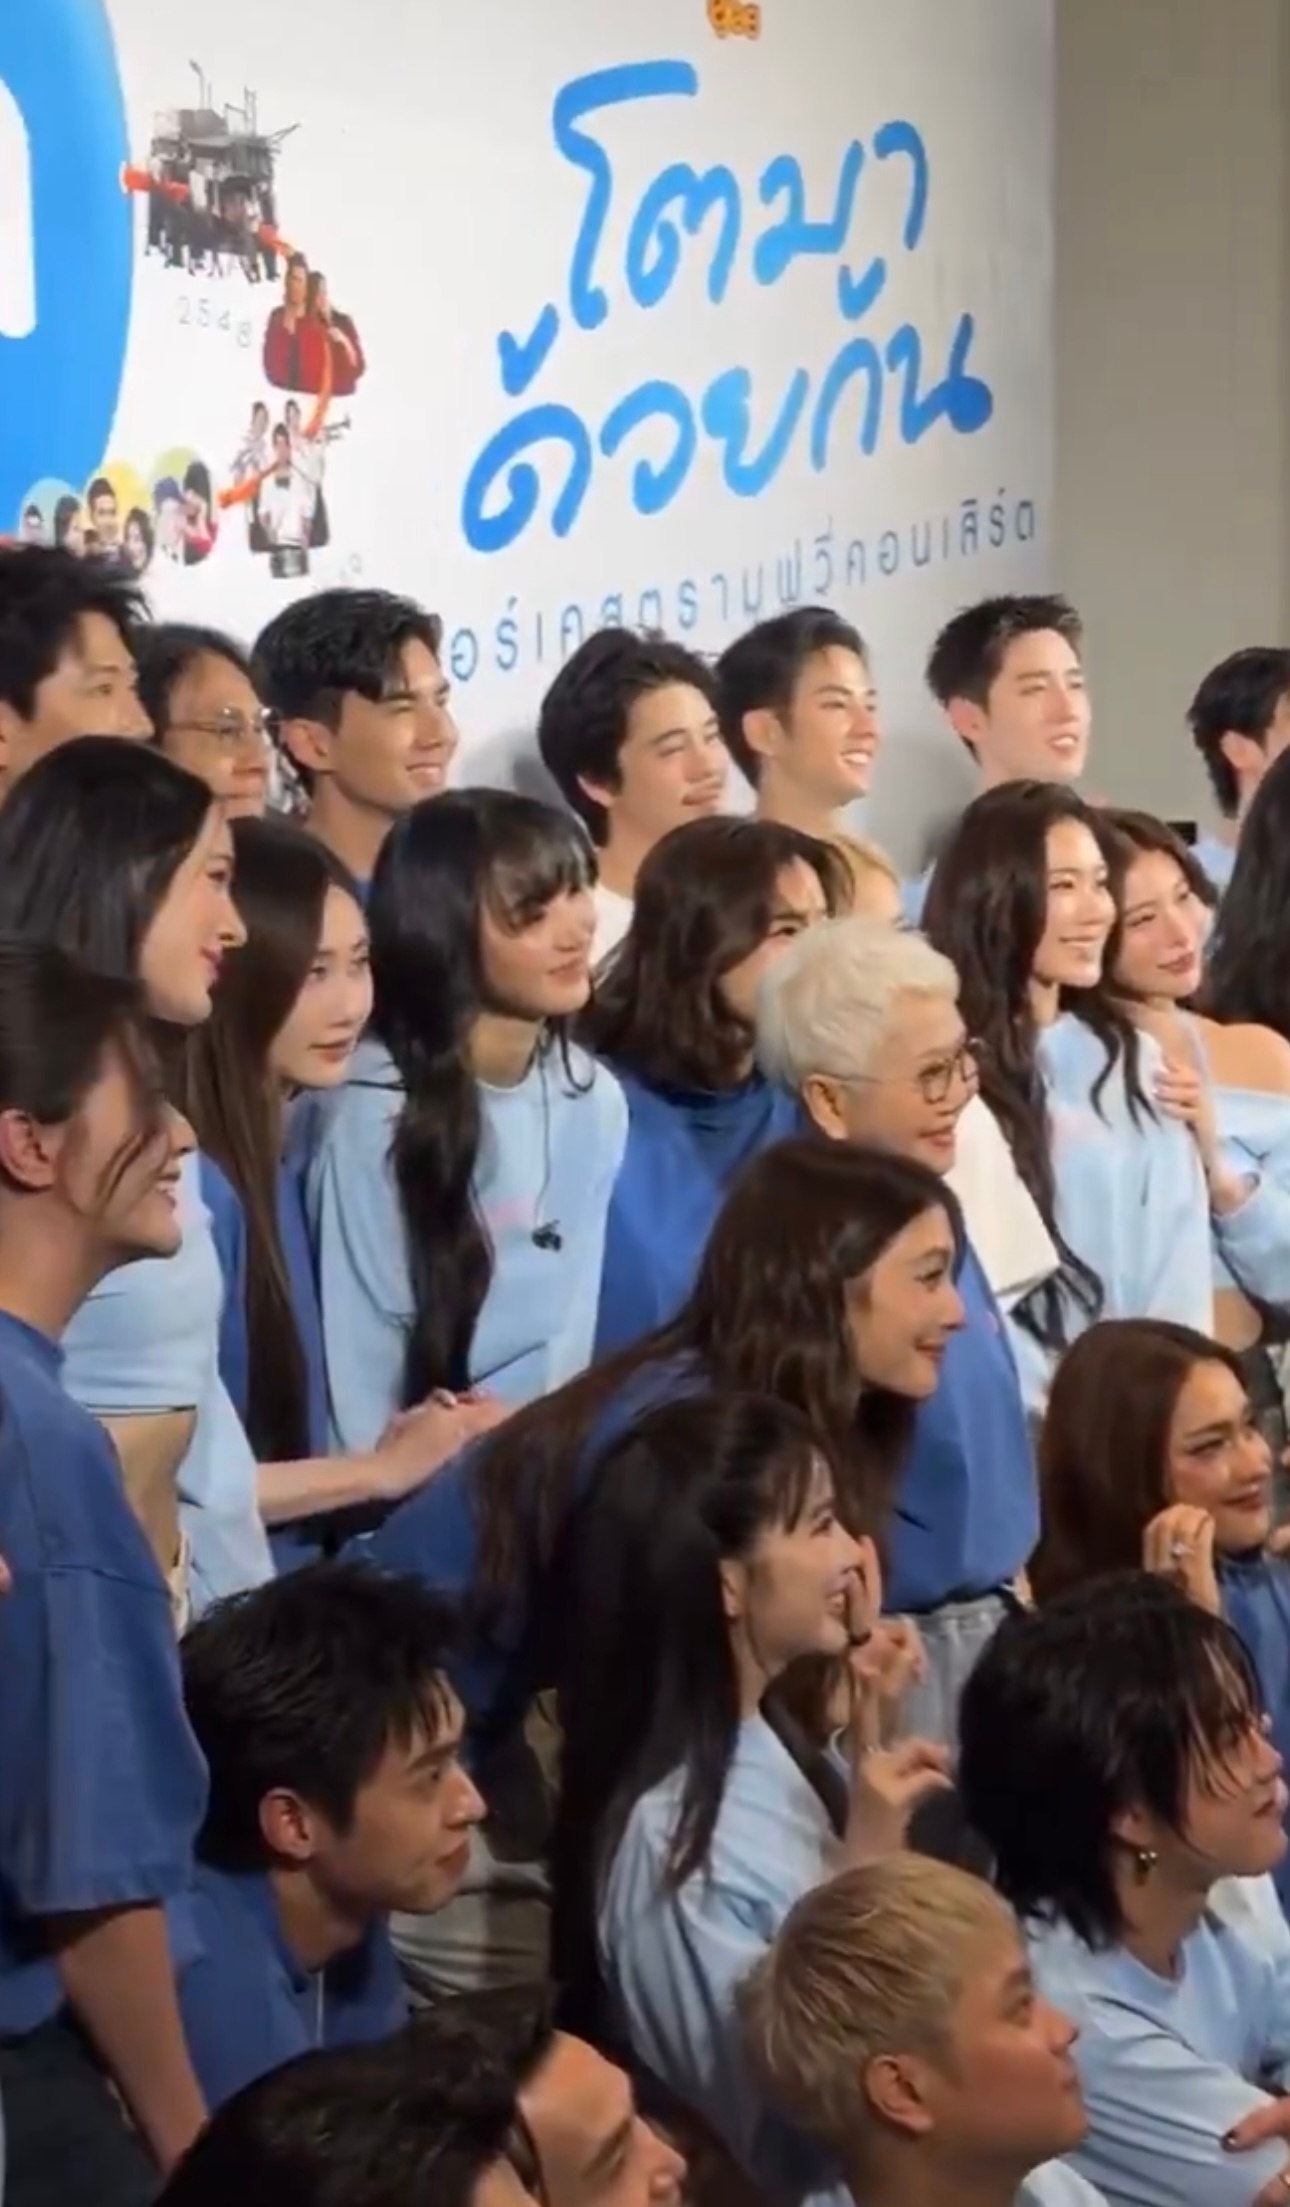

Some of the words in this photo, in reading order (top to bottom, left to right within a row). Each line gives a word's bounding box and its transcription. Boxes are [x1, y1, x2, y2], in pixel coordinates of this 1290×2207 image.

[178, 295, 252, 349] 2548
[552, 59, 928, 329] โตมา
[461, 257, 993, 553] ด้วยกัน
